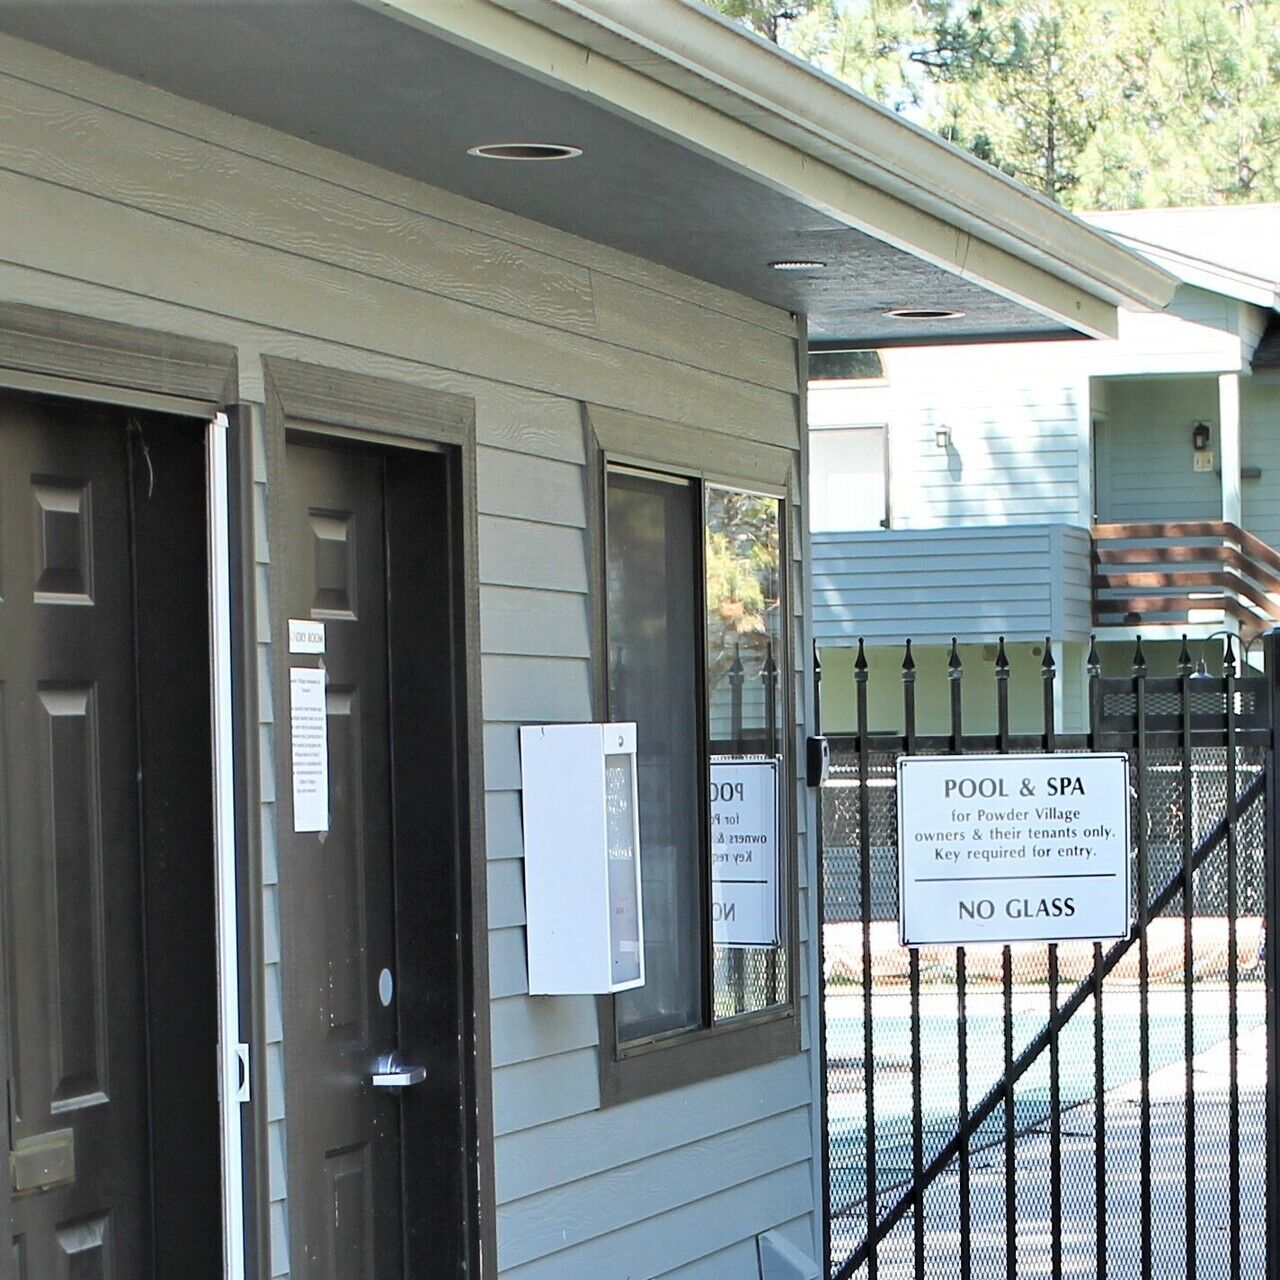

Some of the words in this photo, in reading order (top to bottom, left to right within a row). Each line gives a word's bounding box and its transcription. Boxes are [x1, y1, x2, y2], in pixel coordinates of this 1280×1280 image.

[944, 778, 1009, 798] POOL
[1019, 778, 1036, 798] &
[1047, 777, 1085, 796] SPA
[951, 809, 971, 823] for
[977, 808, 1029, 822] Powder
[1035, 806, 1081, 824] Village
[914, 831, 966, 842] owners
[972, 829, 983, 841] &
[989, 826, 1021, 840] their
[1028, 826, 1078, 839] tenants
[1083, 825, 1116, 840] only.
[934, 847, 960, 864] Key
[967, 845, 1026, 862] required
[1032, 845, 1051, 858] for
[1057, 845, 1097, 860] entry.
[958, 899, 995, 919] NO
[1005, 897, 1075, 918] GLASS
